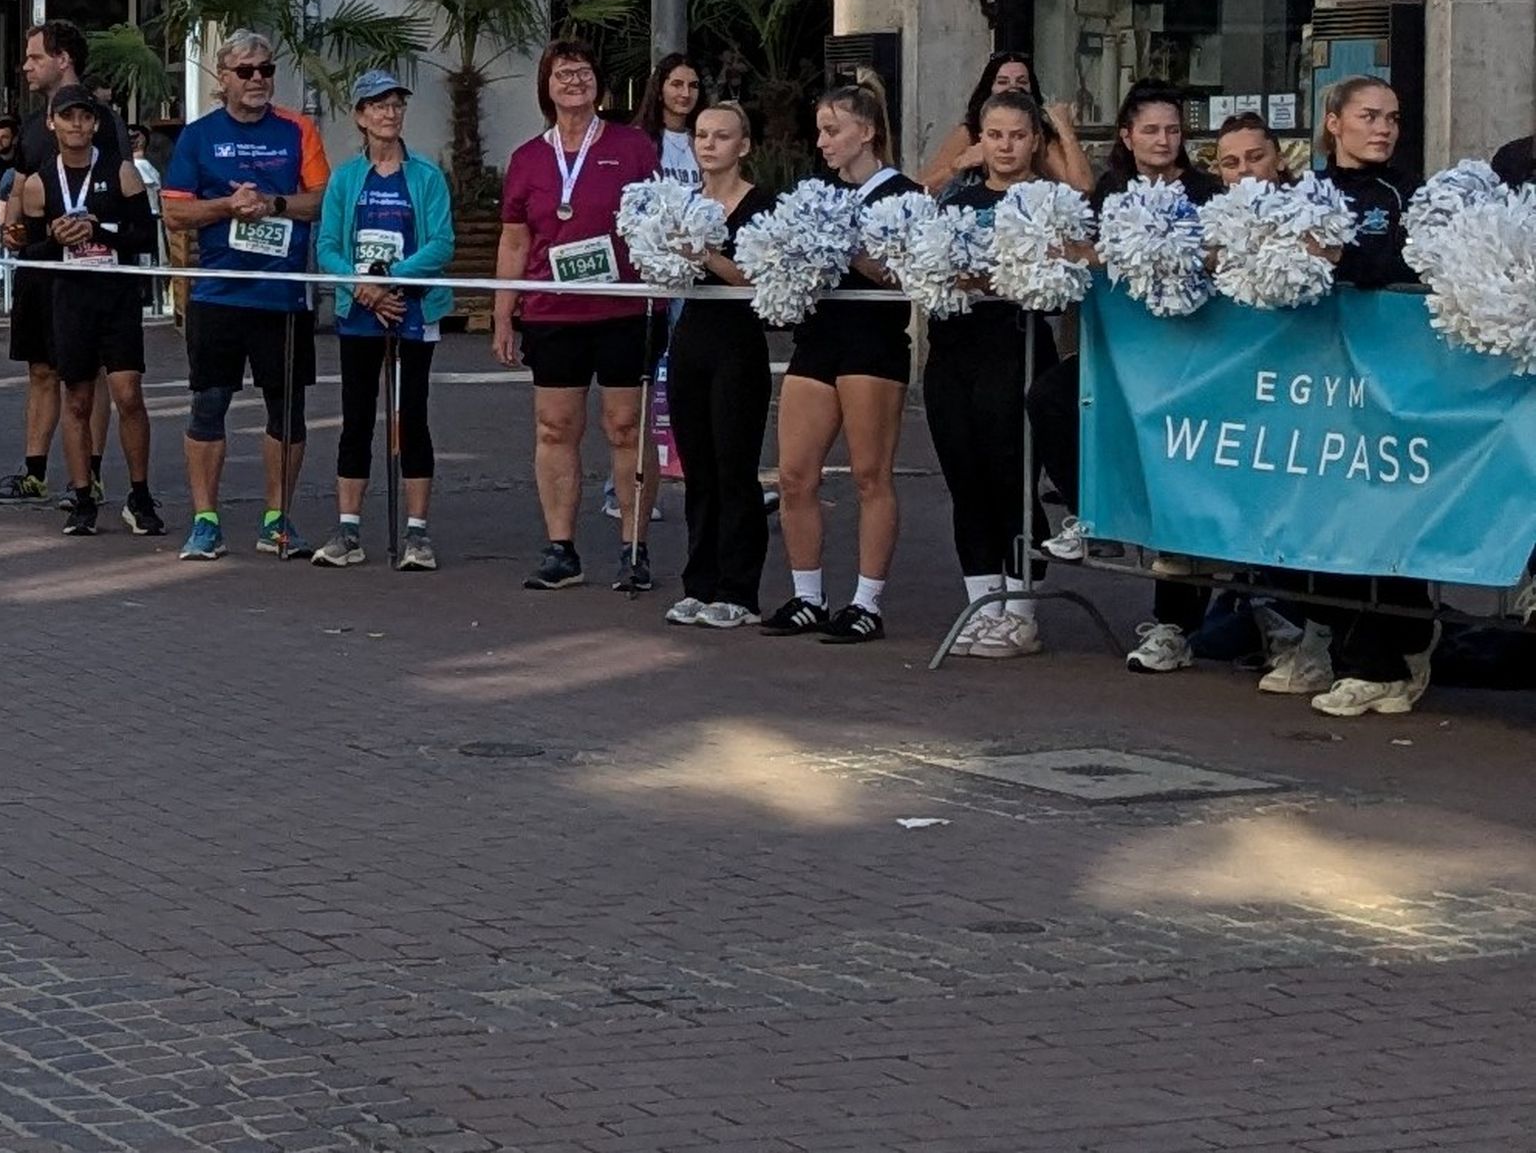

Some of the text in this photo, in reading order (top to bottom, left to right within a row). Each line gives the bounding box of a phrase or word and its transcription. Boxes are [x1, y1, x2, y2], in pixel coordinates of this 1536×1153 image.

[238, 222, 283, 241] 15625
[559, 253, 604, 277] 11947
[1255, 371, 1364, 408] EGYM
[1165, 415, 1430, 484] WELLPASS
